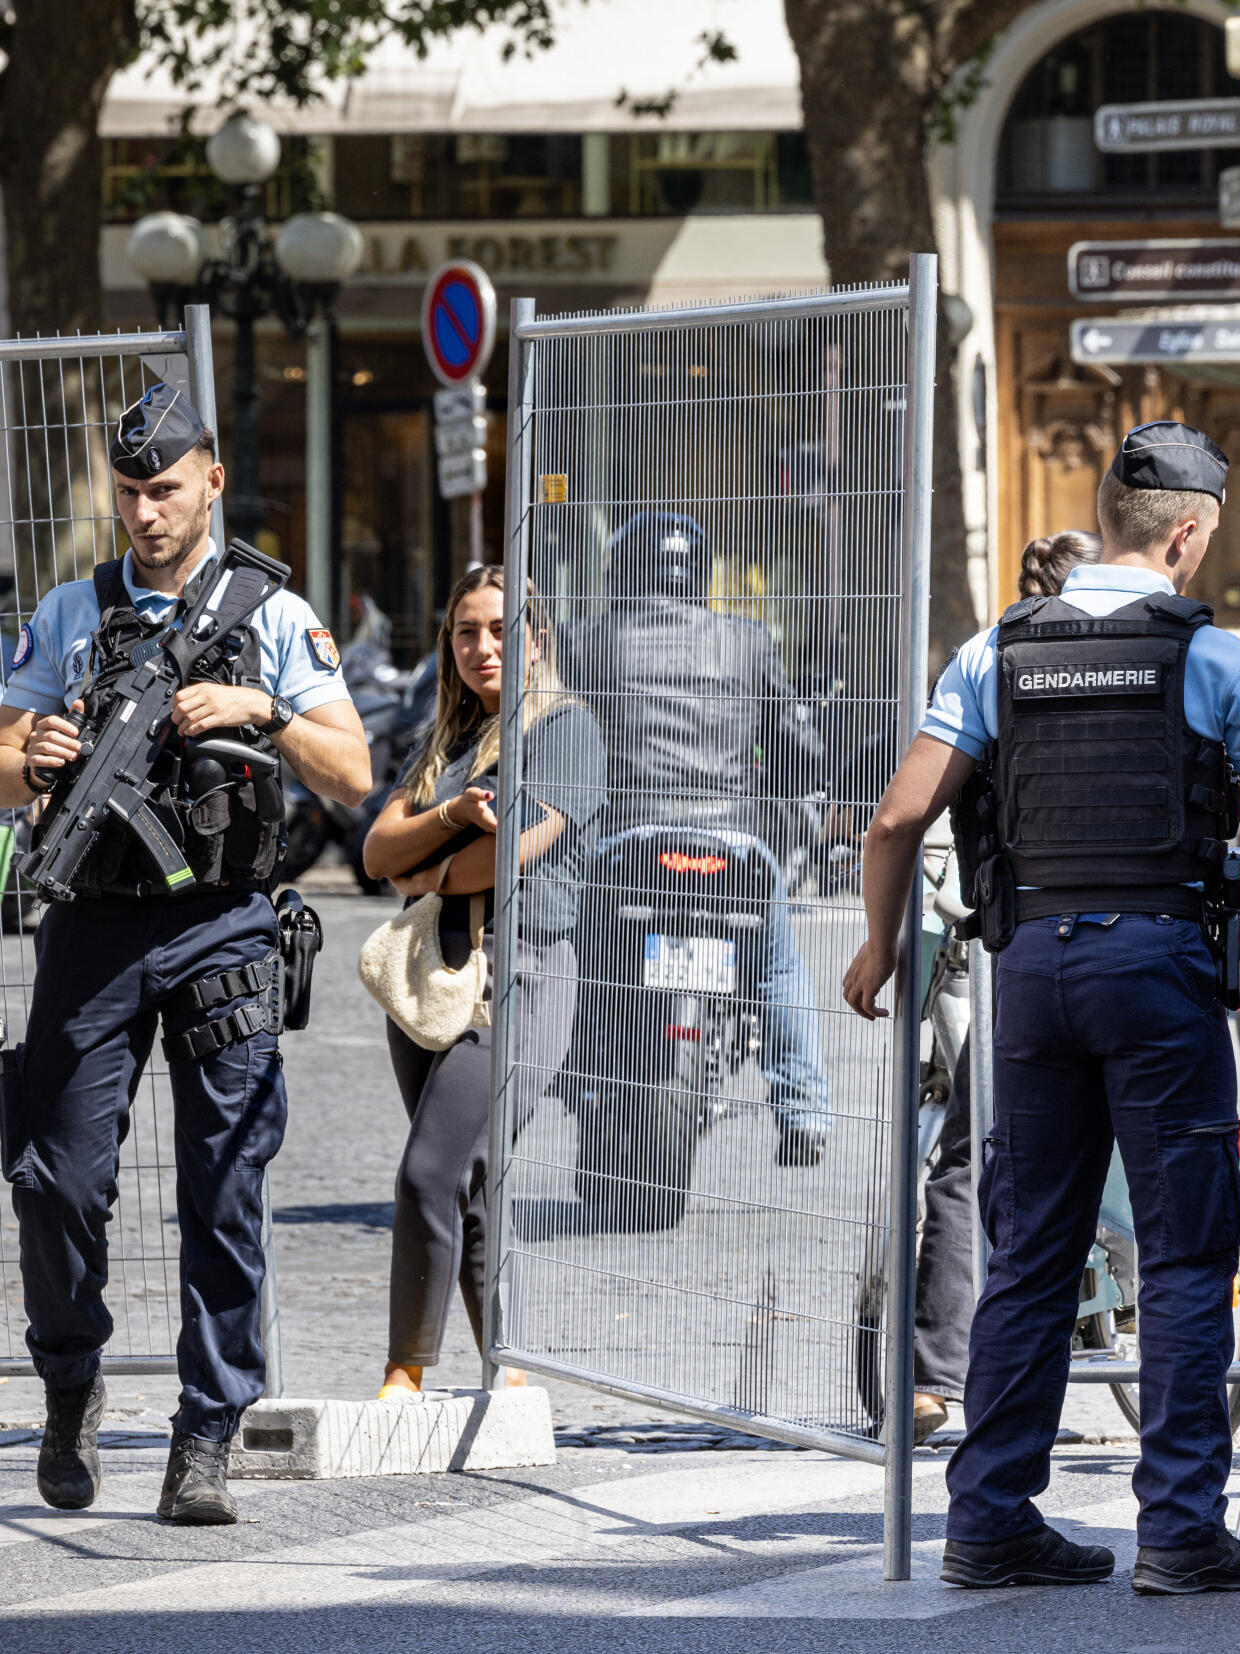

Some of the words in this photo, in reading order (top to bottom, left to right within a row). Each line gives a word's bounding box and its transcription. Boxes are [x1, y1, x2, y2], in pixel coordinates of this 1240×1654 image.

[446, 234, 619, 274] FOREST
[1111, 259, 1174, 281] Conseil
[1018, 670, 1156, 690] GENDARMERIE
